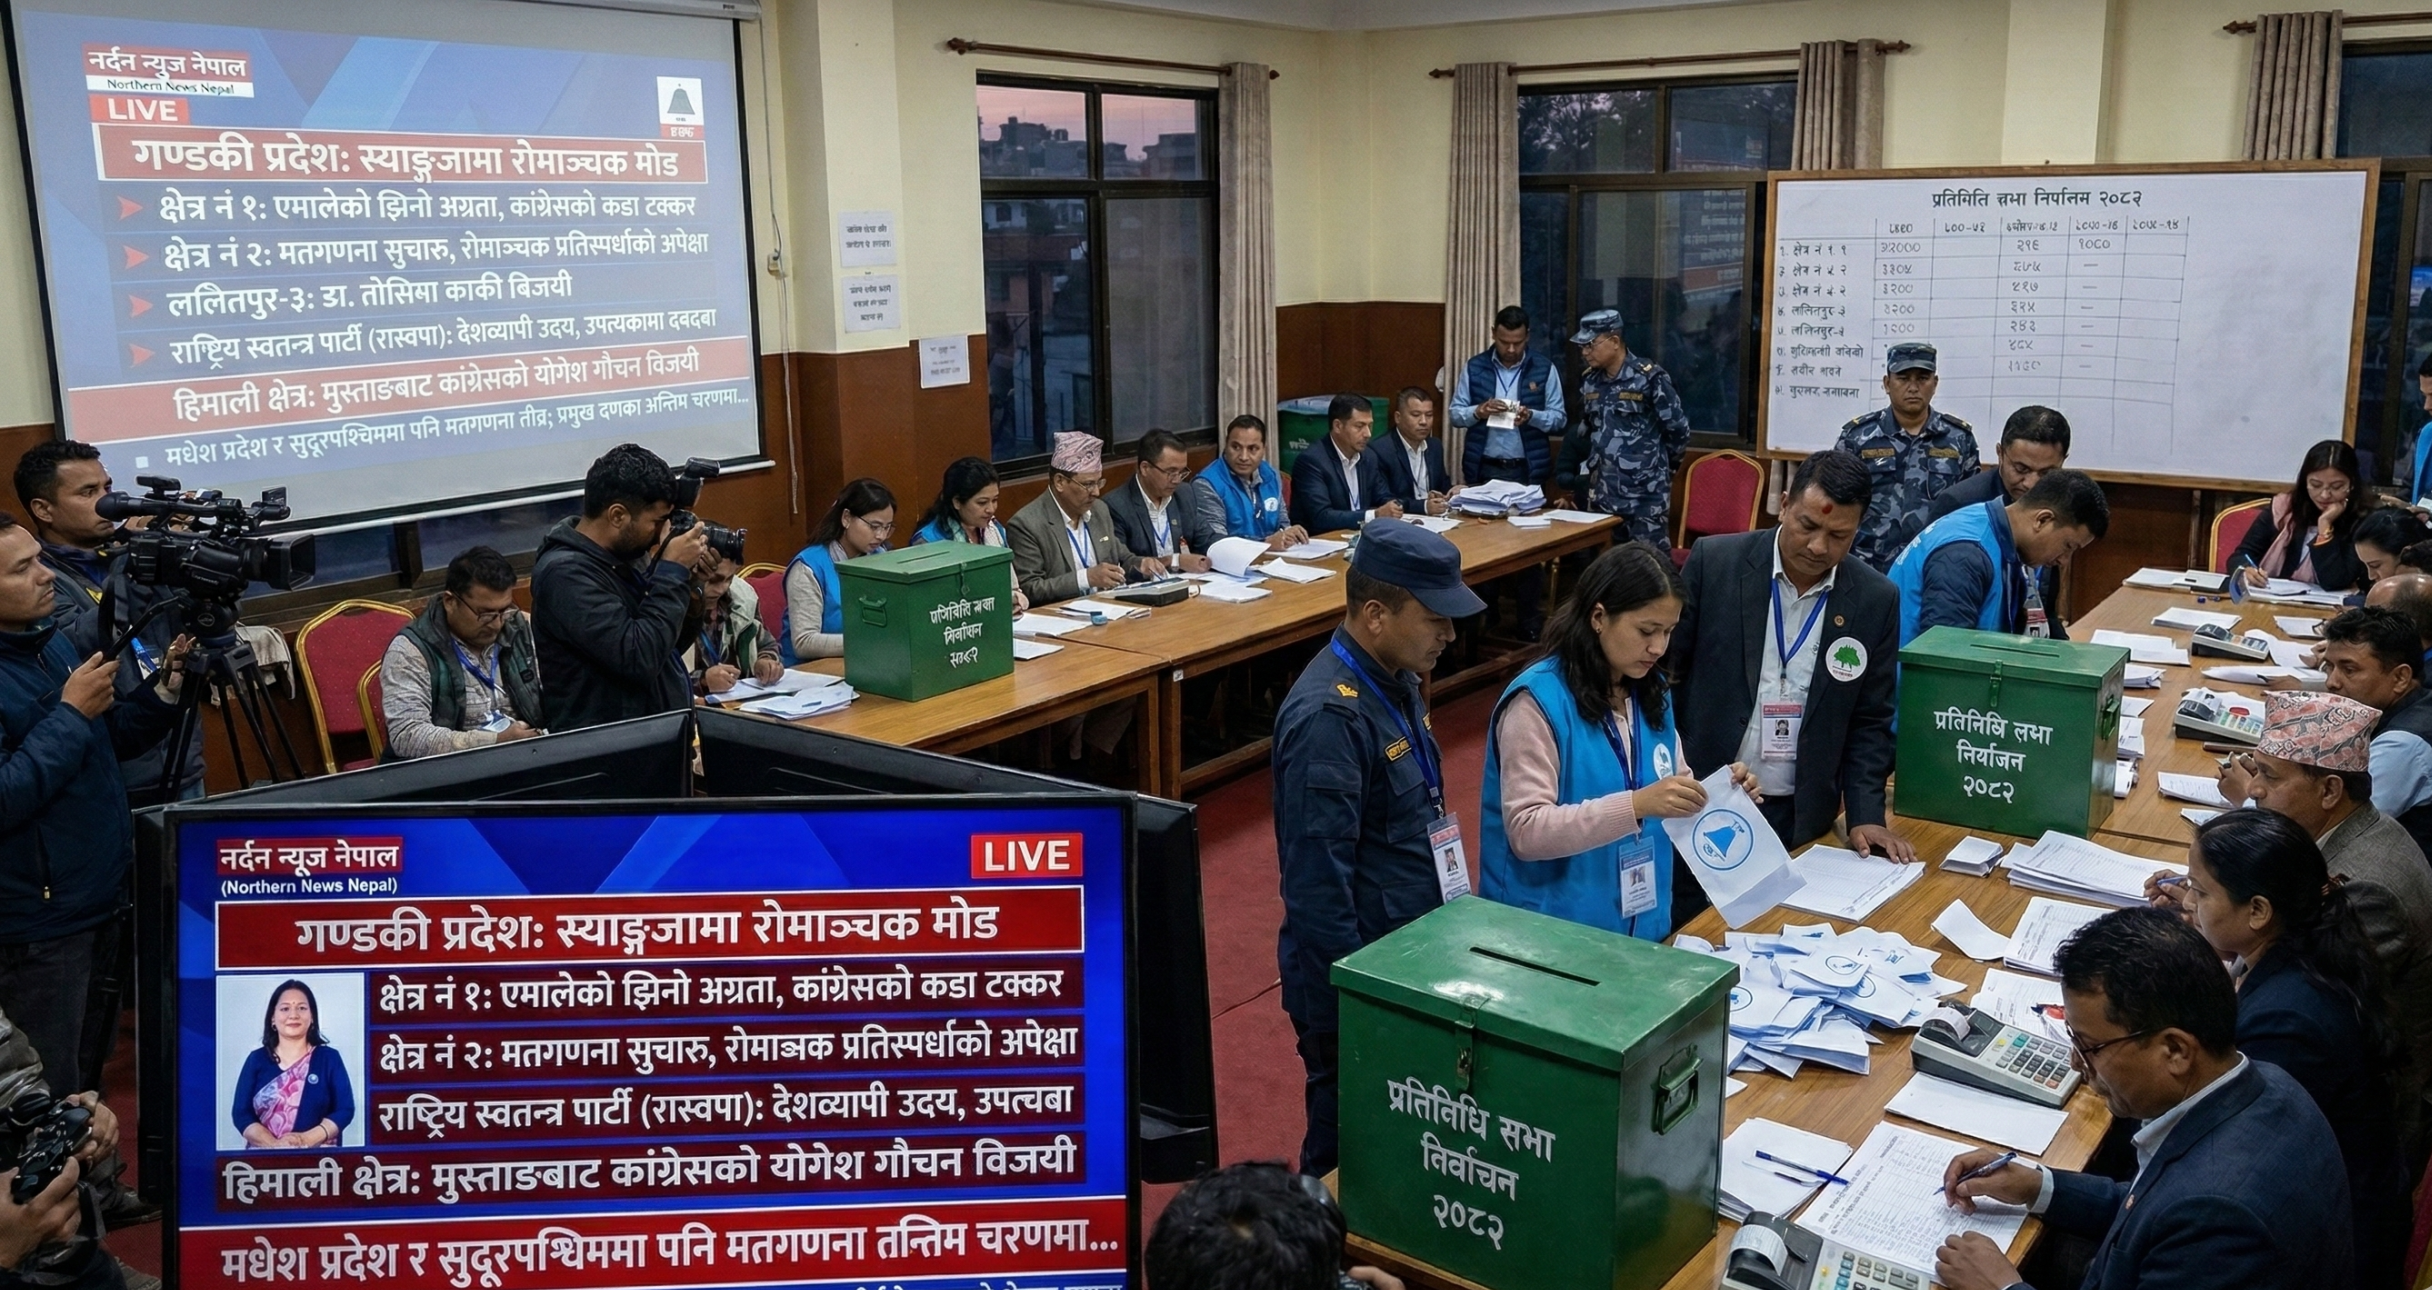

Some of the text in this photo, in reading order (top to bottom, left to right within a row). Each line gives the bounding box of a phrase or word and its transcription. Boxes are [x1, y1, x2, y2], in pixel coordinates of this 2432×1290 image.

[89, 46, 136, 71] नर्दन
[191, 51, 246, 77] नेपाल
[108, 98, 178, 122] LIVE
[131, 131, 254, 171] गण्डकी
[262, 132, 350, 175] प्रदेश:
[510, 138, 628, 176] रोमाञ्चक
[634, 142, 679, 177] मोड
[160, 187, 696, 223] क्षेत्र नं १: एमालेको झिनो अग्रता, कांग्रेसको कडा टक्कर
[164, 227, 709, 272] क्षेत्र नं २: मतगणना सुचारु, रोमाञ्चक प्रतिस्पर्धाको अपेक्षा
[166, 281, 314, 320] ललितपुर-३:
[320, 285, 354, 308] डा.
[444, 271, 503, 301] काकी
[508, 269, 572, 299] बिजयी
[245, 333, 314, 360] स्वतन्त्र
[318, 323, 363, 353] पार्टी
[456, 313, 533, 345] देशव्यापी
[537, 316, 580, 340] उदय,
[584, 312, 664, 336] उपत्यकामा
[173, 345, 700, 422] हिमाली क्षेत्र: मुस्ताङबाट कांग्रेसको योगेश गौचन विजयी
[165, 440, 217, 466] मधेश
[222, 433, 268, 461] प्रदेश
[271, 435, 283, 455] र
[288, 422, 405, 459] सुदूरपश्चिममा
[410, 415, 440, 440] पनि
[445, 412, 515, 436] मतगणना
[556, 404, 595, 429] प्रमुख
[1963, 775, 2015, 804] २०८२
[220, 839, 399, 876] नर्दन न्यूज नेपाल
[984, 840, 1070, 872] LIVE
[220, 877, 398, 897] (Northern News Nepal)
[295, 906, 431, 953] गण्डकी
[441, 904, 544, 953] प्रदेश:
[752, 898, 921, 945] रोमाञ्चक
[932, 895, 1000, 940] मोड
[380, 964, 1064, 1014] क्षेत्र नं १: एमालेको झिनो अग्रता, कांग्रेसको कडा टक्कर
[380, 1033, 426, 1073] क्षेत्र
[434, 1033, 456, 1070] नं
[464, 1042, 492, 1070] २:
[502, 1038, 618, 1067] मतगणना
[627, 1036, 716, 1075] सुचारु,
[842, 1019, 993, 1060] प्रतिस्पर्धाको
[1000, 1019, 1078, 1057] अपेक्षा
[379, 1092, 467, 1139] राष्ट्रिय
[474, 1099, 565, 1130] स्वतन्त्र
[572, 1087, 634, 1125] पार्टी
[772, 1080, 889, 1121] देशव्यापी
[898, 1088, 965, 1121] उदय,
[1498, 1115, 1556, 1163] सभा
[222, 1134, 1077, 1205] हिमाली क्षेत्र: मुस्ताङबाट कांग्रेसको योगेश गौचन विजयी
[1433, 1194, 1505, 1251] २०८२
[221, 1236, 309, 1283] मधेश
[319, 1233, 399, 1282] प्रदेश
[408, 1241, 428, 1278] र
[437, 1226, 647, 1290] सुदूरपश्चिममा
[656, 1221, 716, 1267] पनि
[726, 1226, 867, 1265] मतगणना
